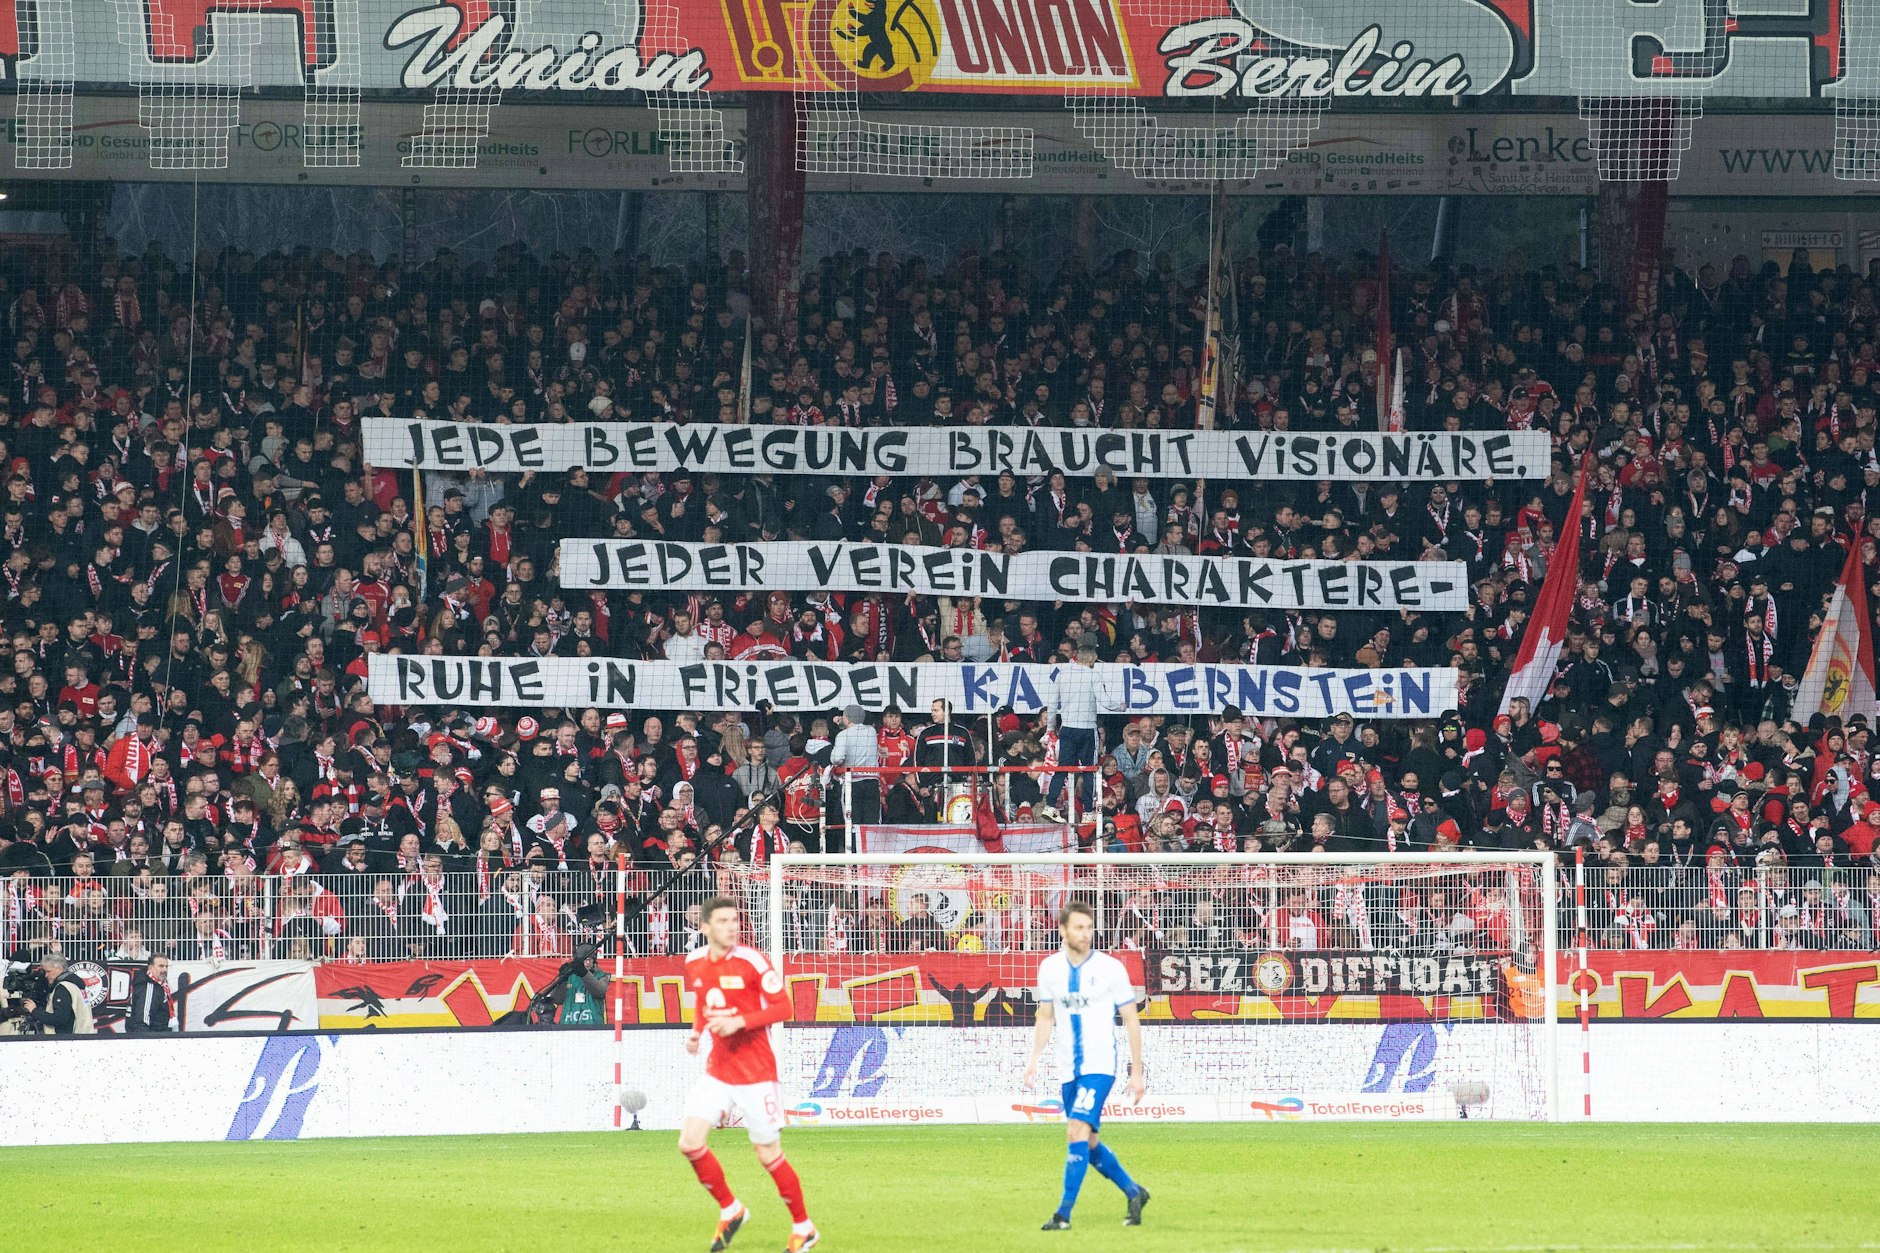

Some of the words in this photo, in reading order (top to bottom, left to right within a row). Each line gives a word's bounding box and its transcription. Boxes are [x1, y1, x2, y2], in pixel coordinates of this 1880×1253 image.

[385, 5, 711, 93] Union
[945, 0, 1128, 76] UNION
[1161, 24, 1470, 97] Berlin
[568, 127, 692, 157] FORLIFE
[1288, 152, 1321, 164] GHD
[1327, 152, 1425, 165] GesundHeits
[1466, 127, 1593, 162] Lenke
[1546, 172, 1594, 184] Heizung
[405, 423, 544, 467] JEDE
[585, 425, 908, 471] BEWEGUNG
[949, 430, 1195, 475] BRAUCHT
[589, 543, 765, 586] JEDER
[1050, 556, 1453, 605] CHARAKTERE-
[399, 657, 544, 701] RUHE
[962, 666, 1062, 711] KA
[826, 1107, 944, 1122] TotalEnergies
[1100, 1104, 1186, 1119] alEnergies
[1308, 1101, 1425, 1117] TotalEnergies
[1073, 1087, 1096, 1111] 26
